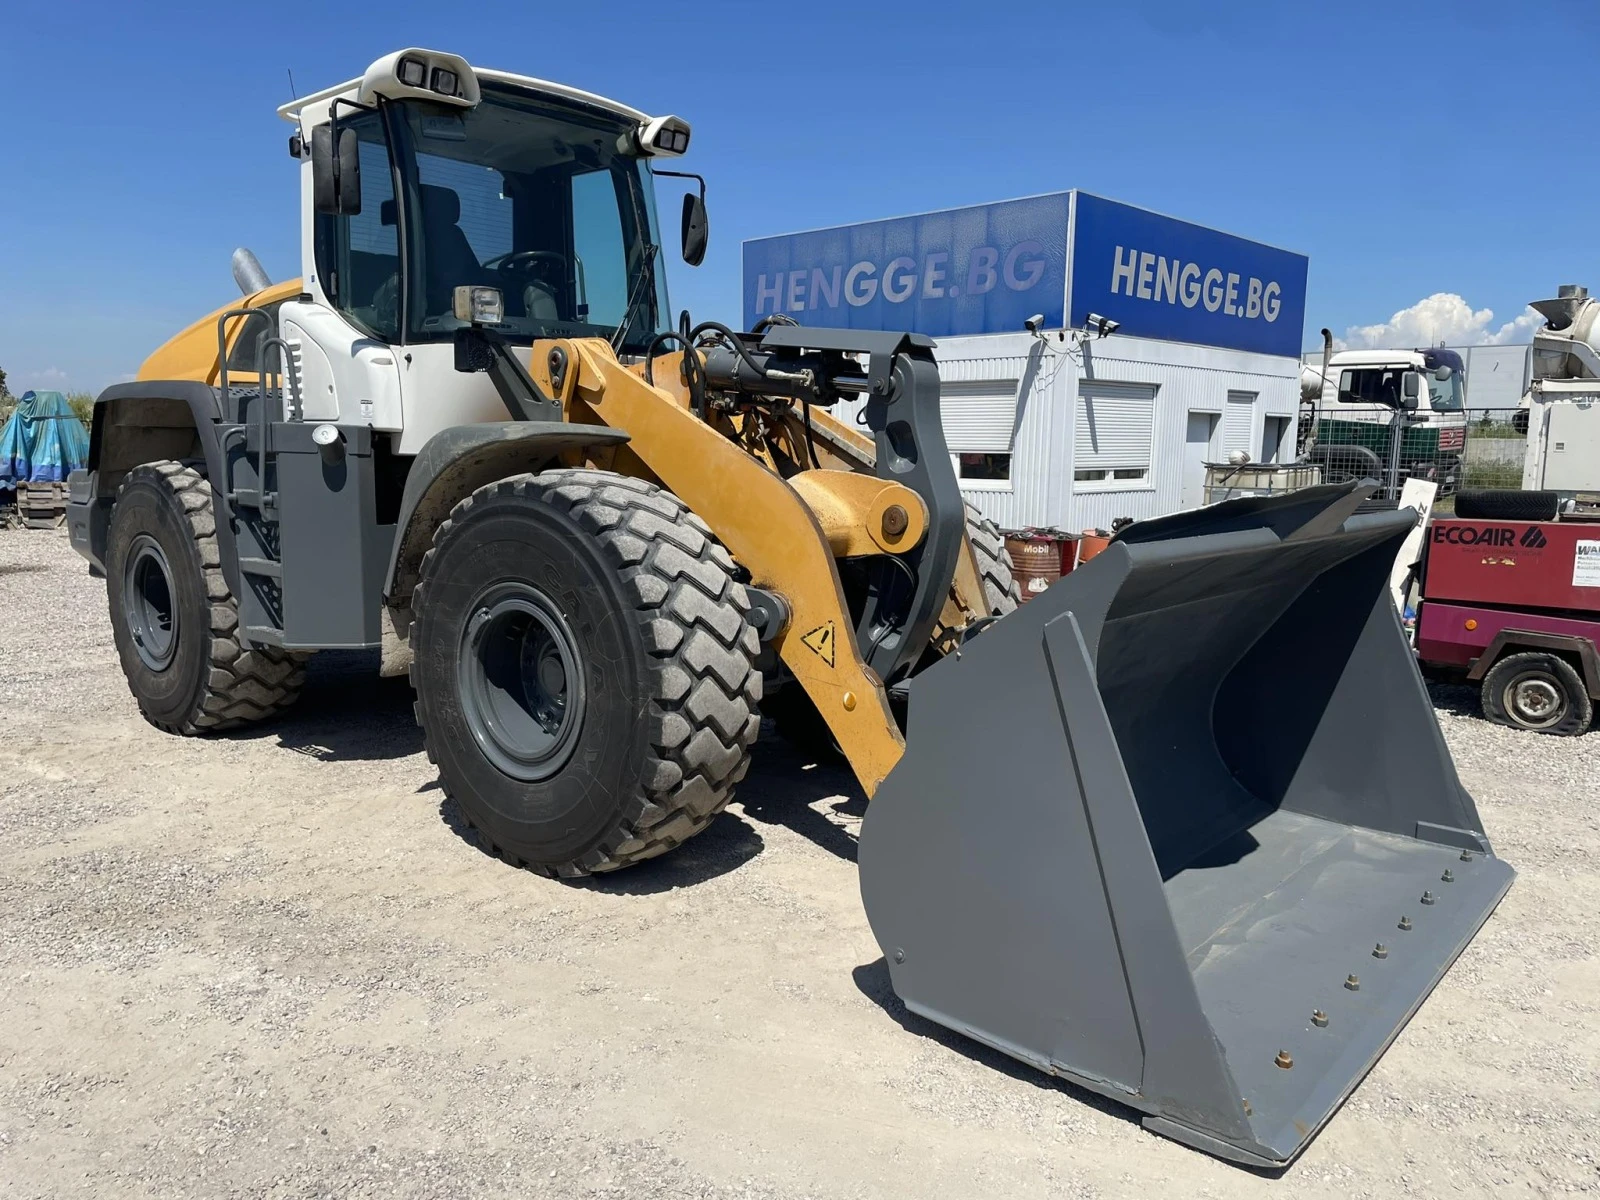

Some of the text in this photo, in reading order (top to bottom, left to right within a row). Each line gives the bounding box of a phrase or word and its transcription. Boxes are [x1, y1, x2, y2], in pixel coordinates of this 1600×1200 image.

[755, 240, 1047, 314] HENGGE.BG
[1110, 245, 1281, 323] HENGGE.BG
[1433, 525, 1516, 547] ECOAIR
[1023, 544, 1049, 554] Mobil
[1577, 545, 1600, 556] WA
